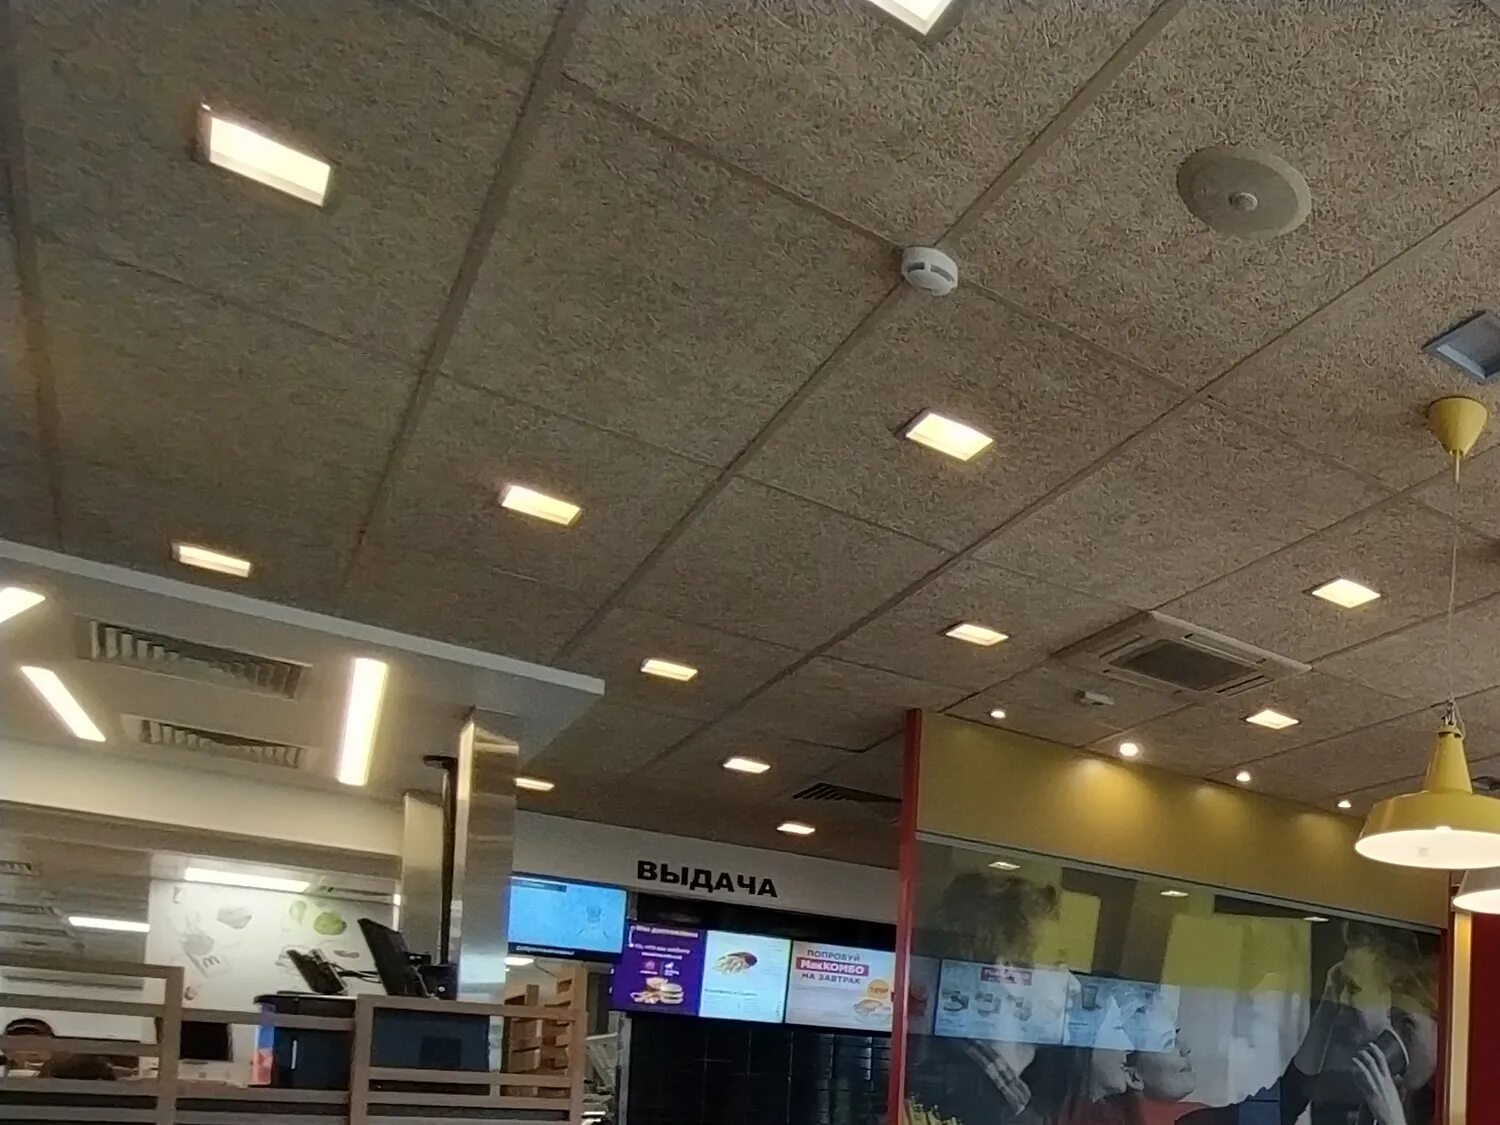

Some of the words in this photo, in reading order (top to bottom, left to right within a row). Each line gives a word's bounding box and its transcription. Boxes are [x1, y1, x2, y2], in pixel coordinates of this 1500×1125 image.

[637, 860, 778, 898] ВЫДАЧА
[807, 949, 861, 962] ПОПРОБУЙ
[802, 973, 816, 981] НА
[818, 974, 861, 985] ЗАВТРАК
